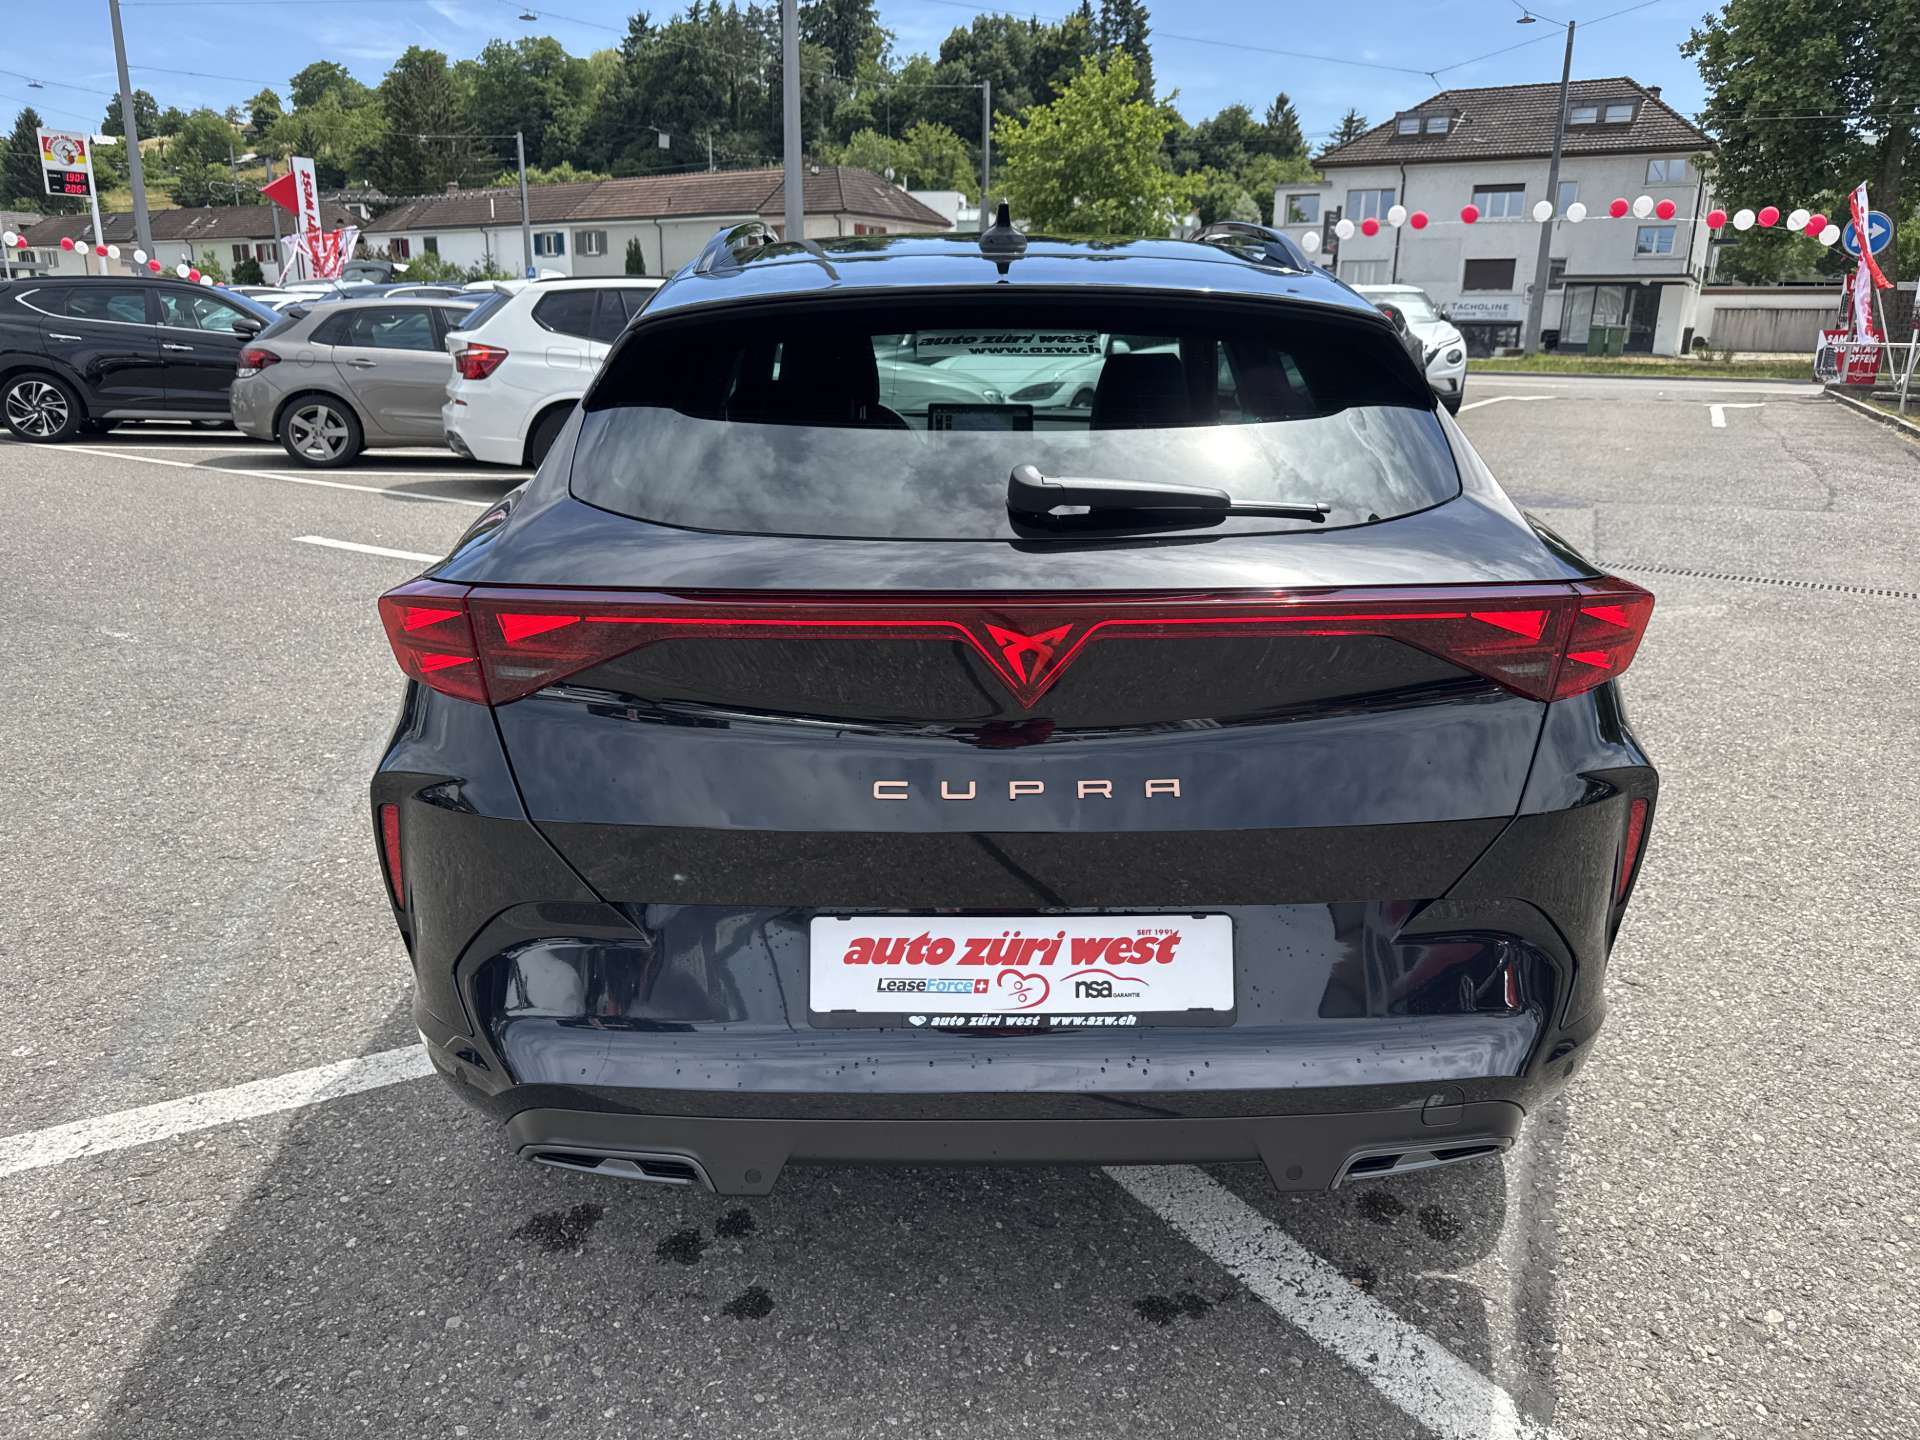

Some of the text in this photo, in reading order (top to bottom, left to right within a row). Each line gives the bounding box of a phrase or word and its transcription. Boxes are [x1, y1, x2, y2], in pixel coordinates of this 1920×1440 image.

[301, 169, 314, 211] west
[918, 333, 1097, 346] auto züri west
[968, 345, 1102, 354] www.azw.ch
[1849, 354, 1877, 363] OFFEN
[873, 778, 1181, 801] CUPRA
[843, 930, 1182, 966] auto züri west
[877, 978, 973, 993] LeaseForce
[1075, 980, 1112, 998] nsa
[930, 1014, 1137, 1026] auto züri west www.azw.ch
